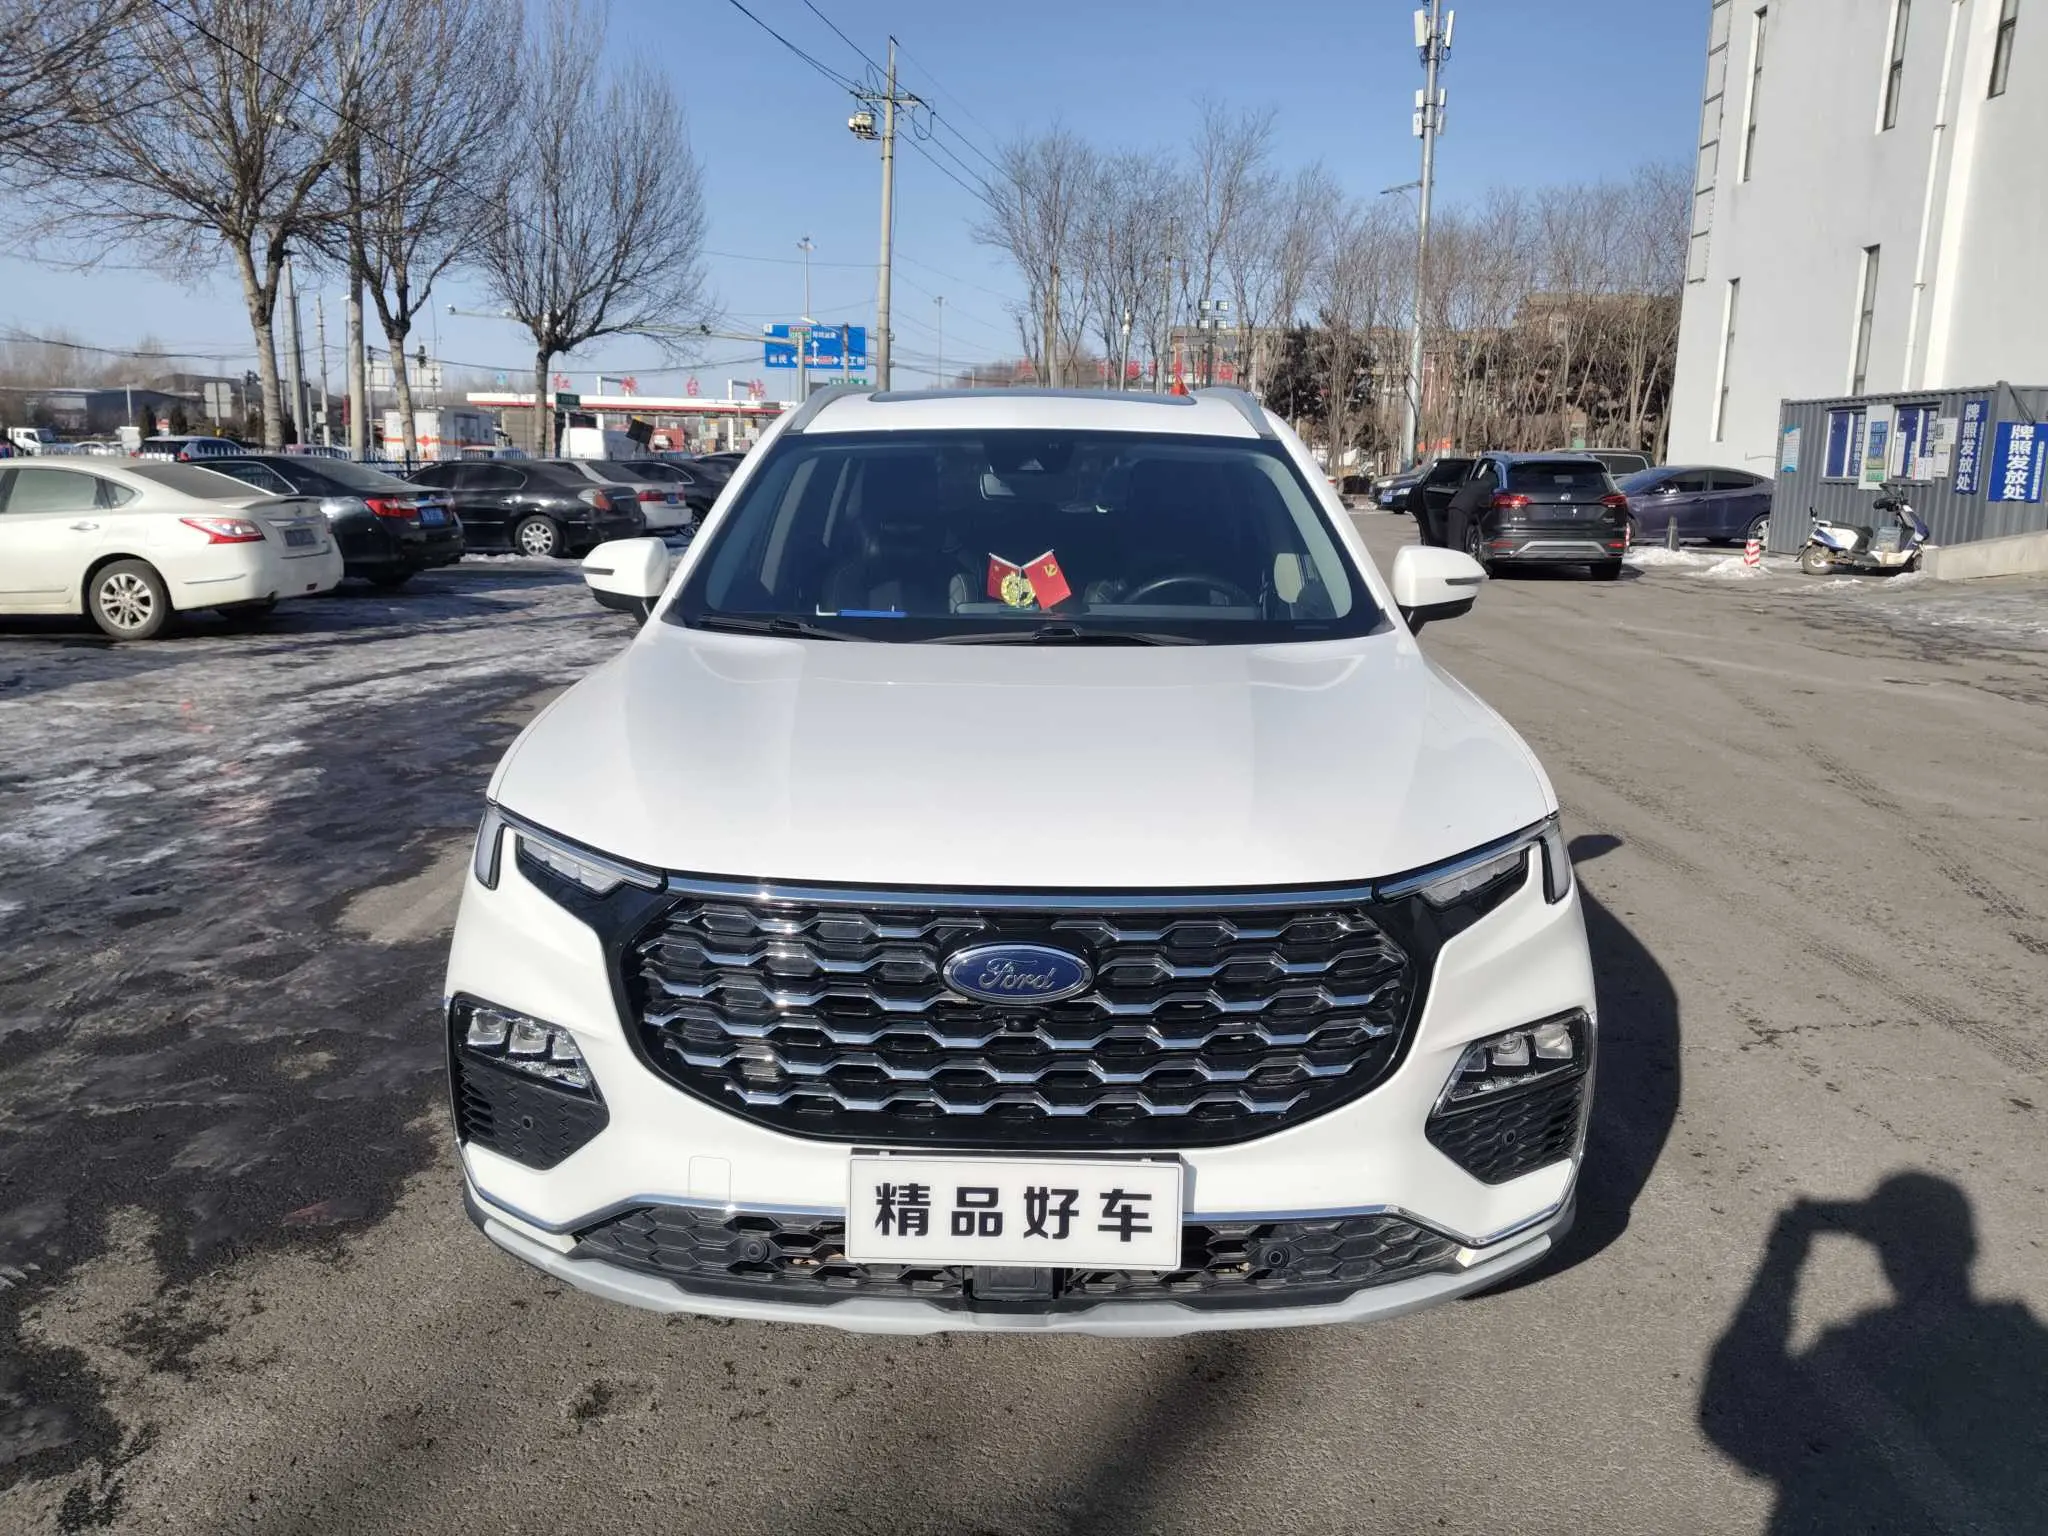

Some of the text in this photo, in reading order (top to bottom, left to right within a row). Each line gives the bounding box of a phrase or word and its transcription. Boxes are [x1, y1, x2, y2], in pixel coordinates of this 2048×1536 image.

[1955, 403, 1980, 491] 牌照发放处
[2002, 425, 2035, 500] 牌照发放处
[978, 957, 1057, 990] Ford
[874, 1182, 1153, 1243] 精品好车
